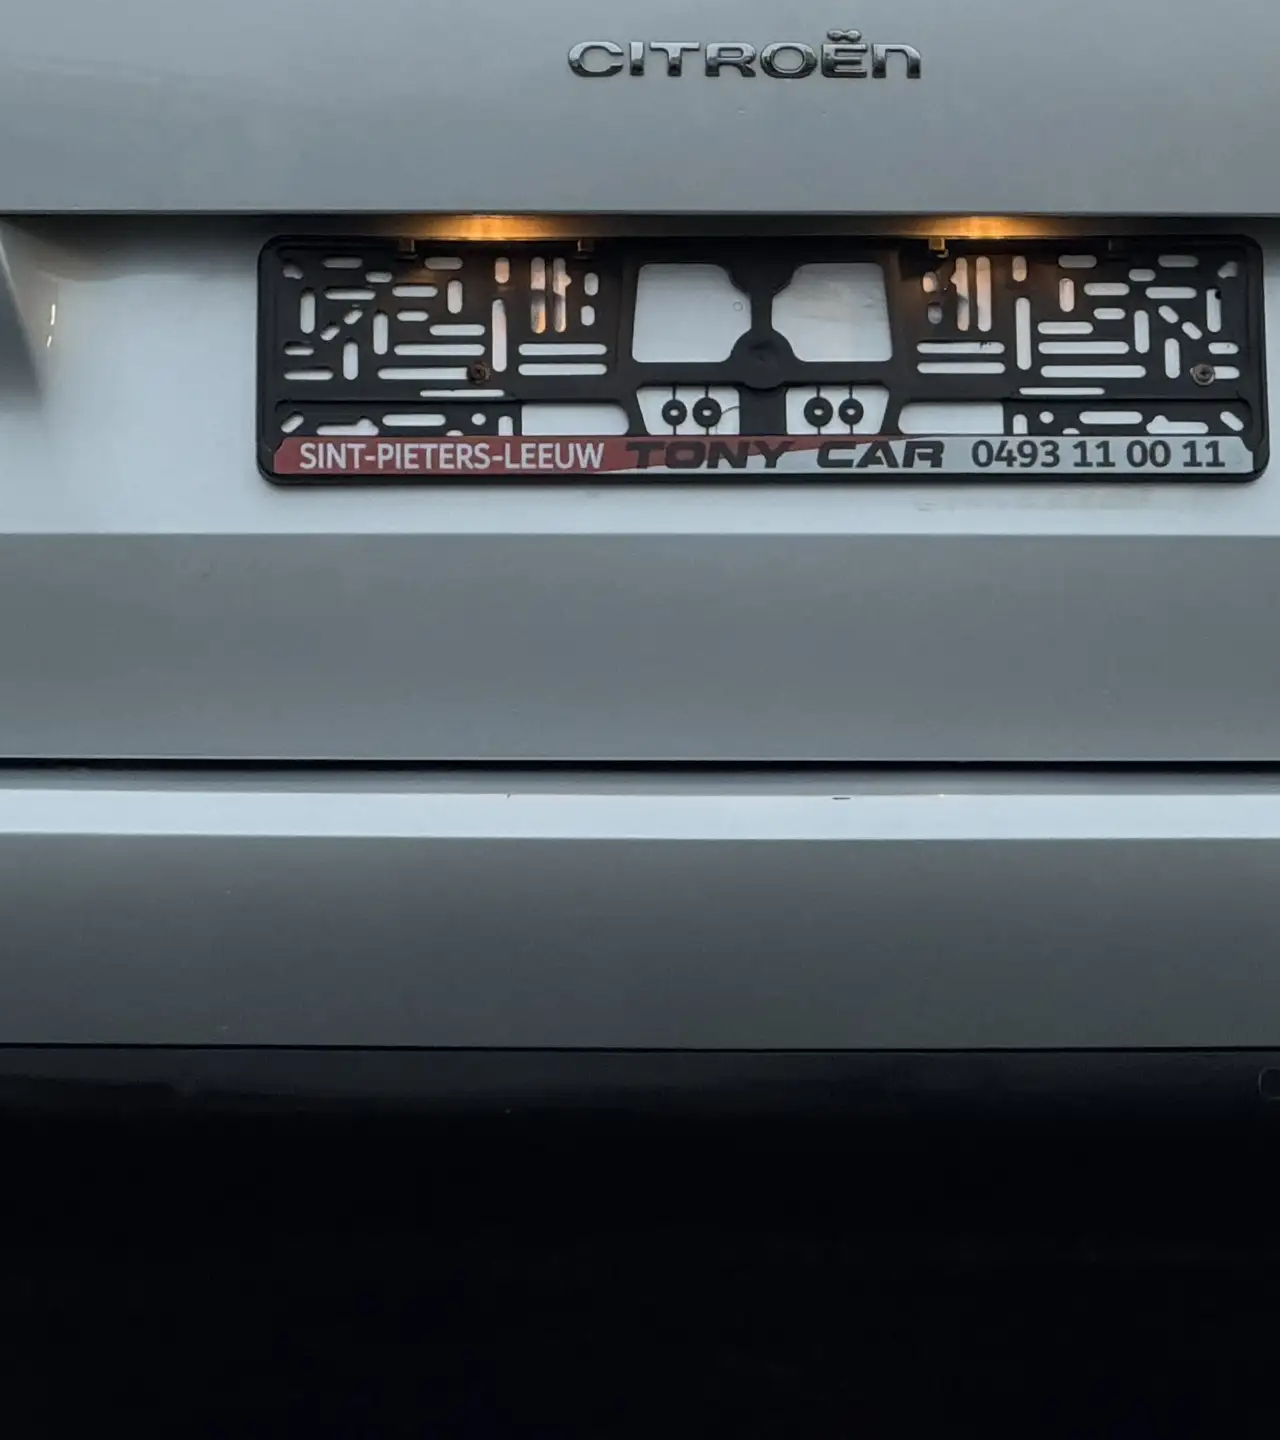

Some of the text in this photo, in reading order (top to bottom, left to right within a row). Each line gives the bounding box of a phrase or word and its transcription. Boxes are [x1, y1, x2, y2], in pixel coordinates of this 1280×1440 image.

[299, 439, 1226, 470] SINT-PIETERS-LEEUW TONY CAR 0493 11 00 11
